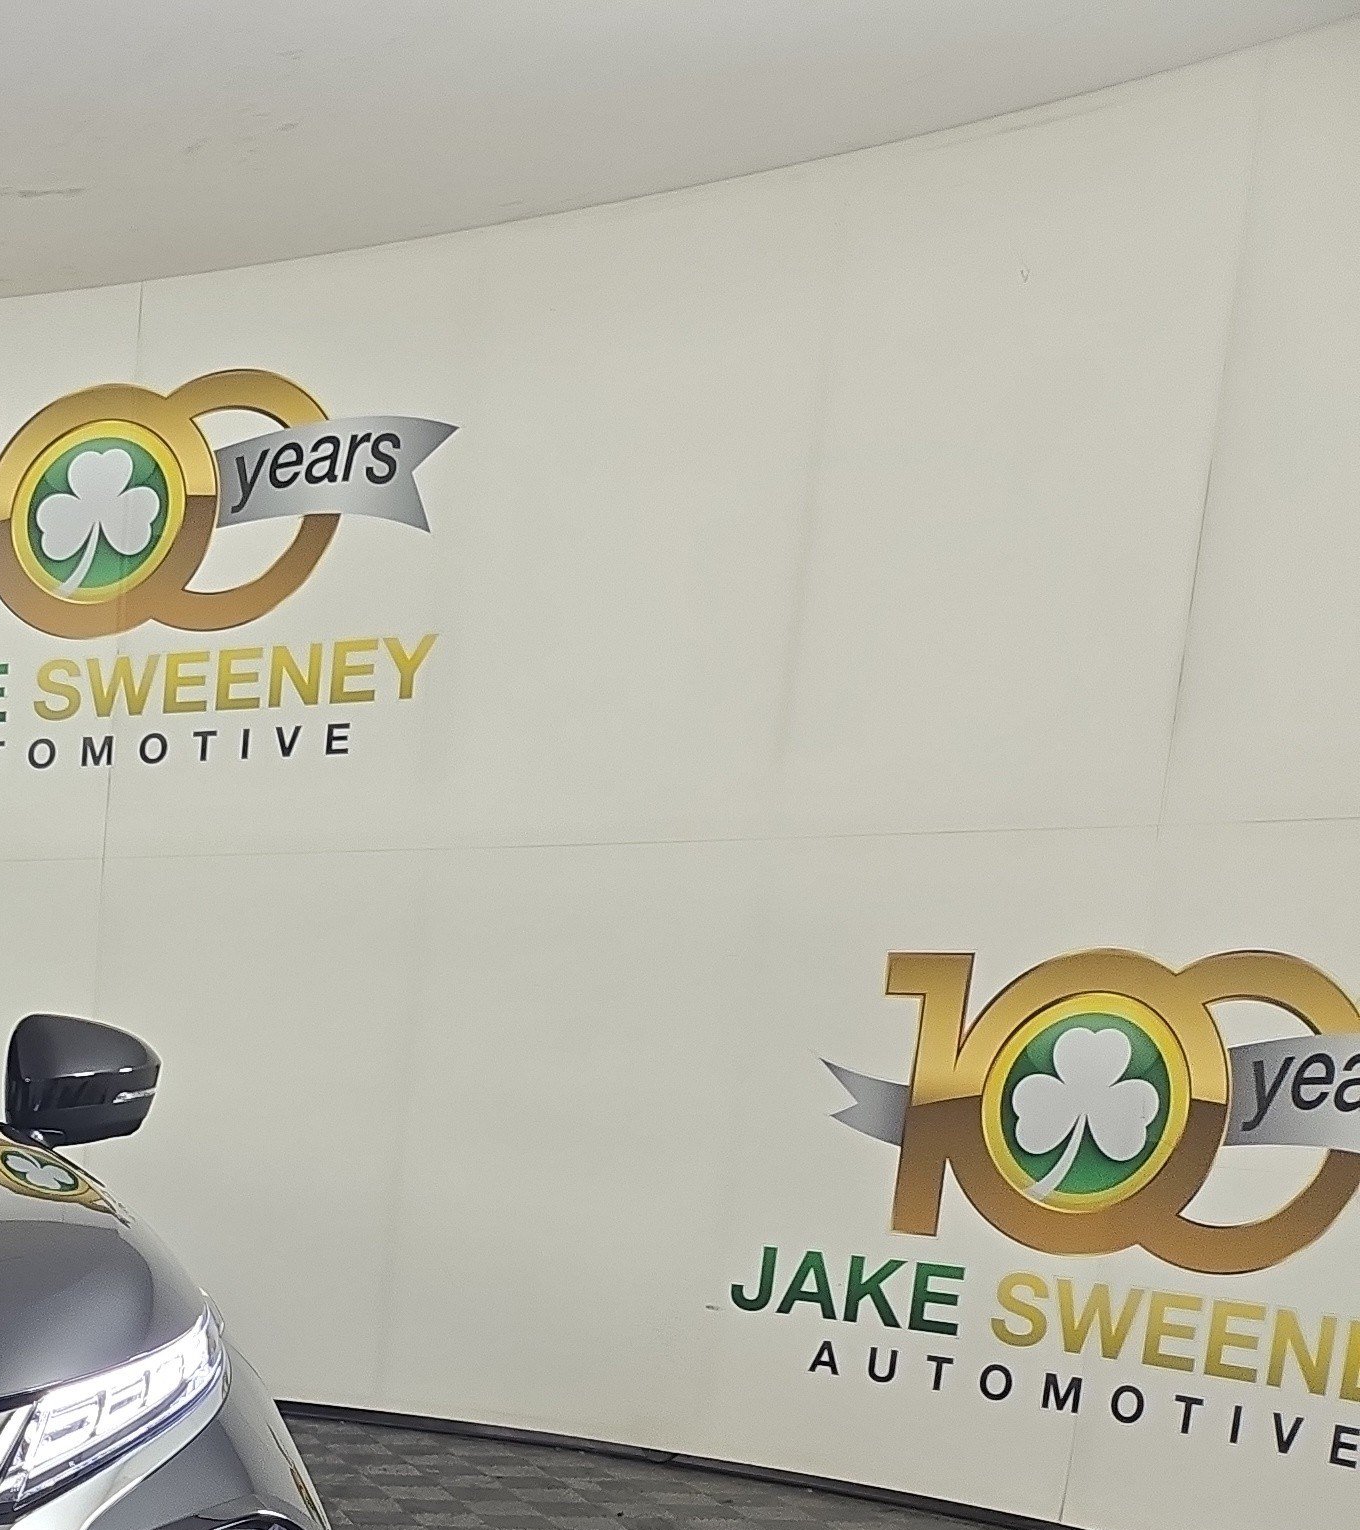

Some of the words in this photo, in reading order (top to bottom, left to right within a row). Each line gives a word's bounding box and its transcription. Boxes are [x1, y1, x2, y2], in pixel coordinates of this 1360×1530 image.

[230, 431, 402, 513] years
[33, 633, 440, 721] SWEENEY
[730, 1244, 967, 1338] JAKE
[808, 1339, 1360, 1470] AUTOMOTIVE
